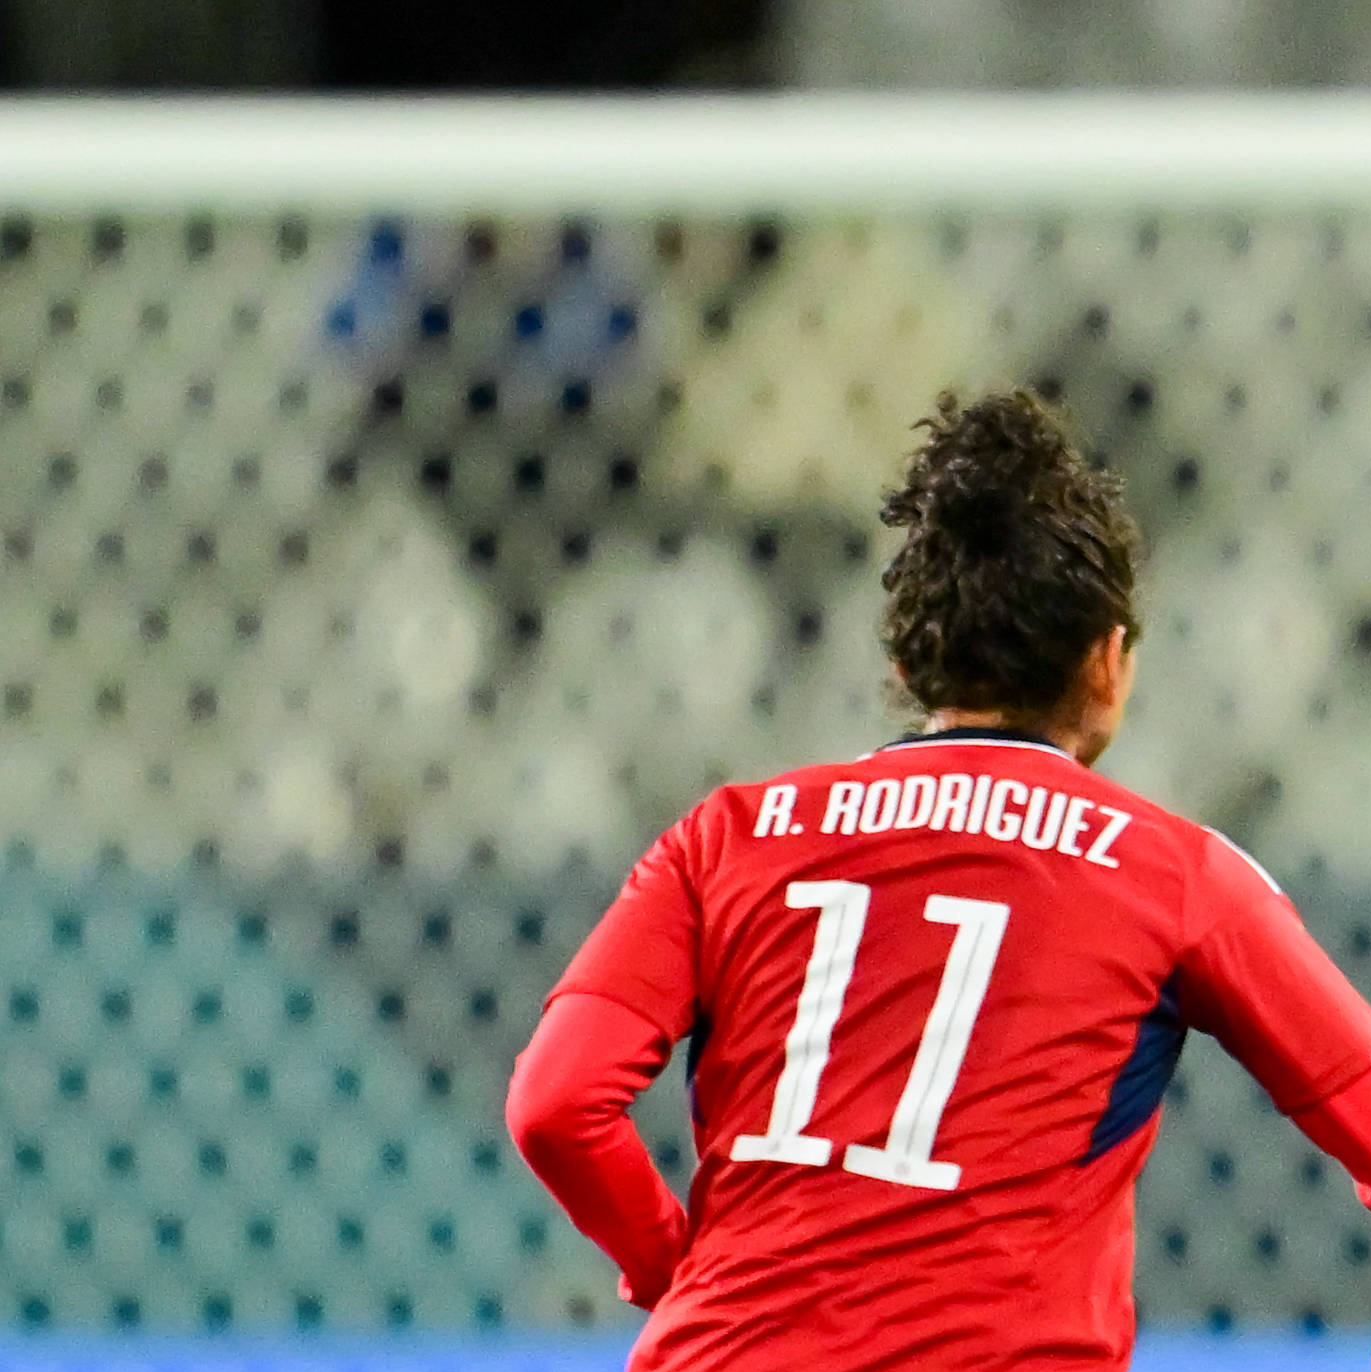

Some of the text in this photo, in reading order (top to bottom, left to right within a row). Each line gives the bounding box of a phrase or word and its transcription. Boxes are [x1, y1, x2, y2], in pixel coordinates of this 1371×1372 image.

[753, 772, 1132, 869] R. RODRIGUEZ
[730, 879, 1010, 1191] 11
